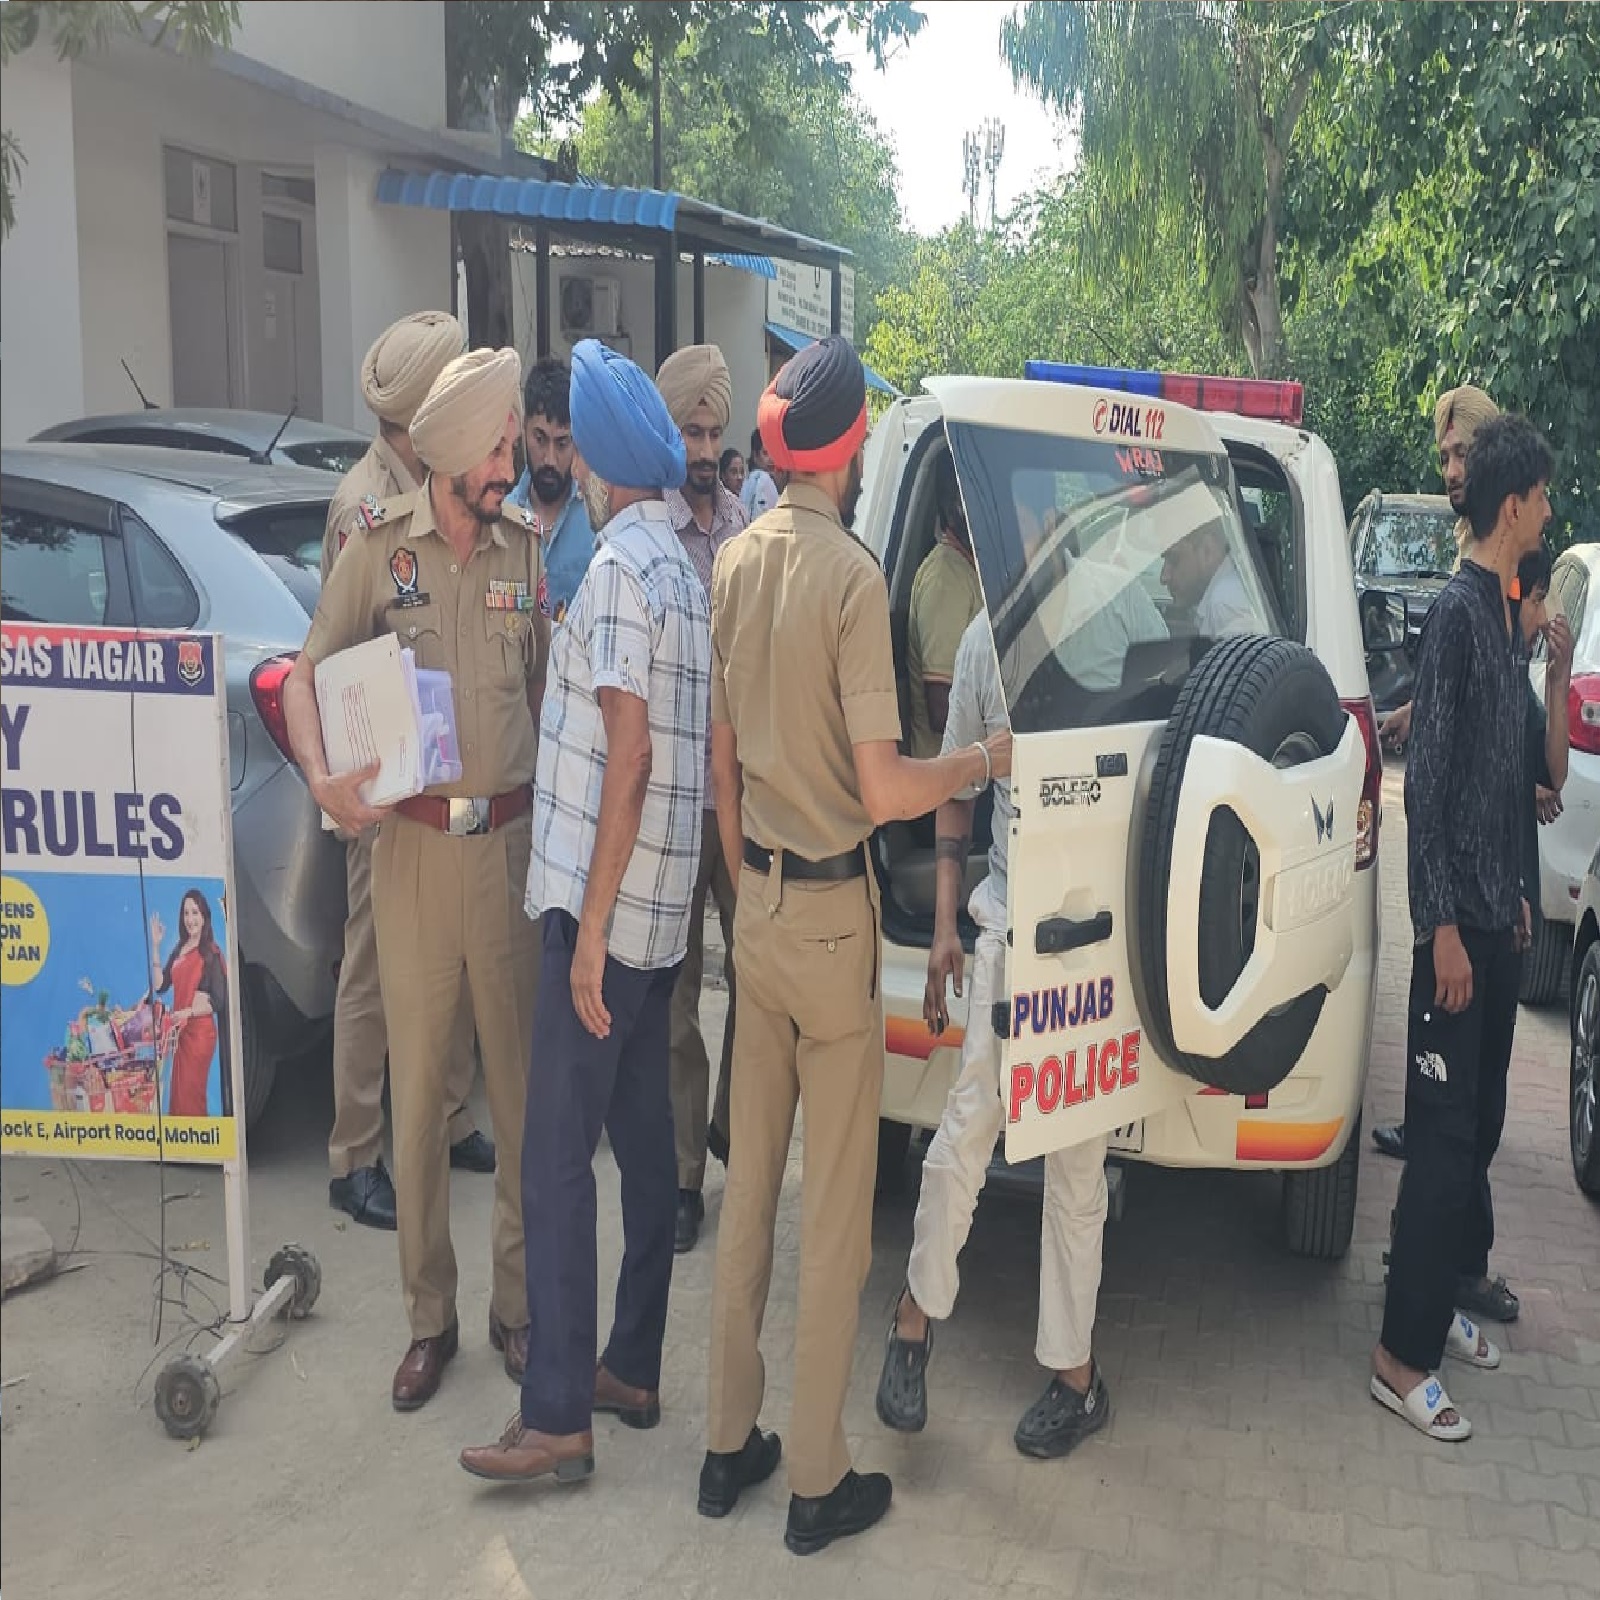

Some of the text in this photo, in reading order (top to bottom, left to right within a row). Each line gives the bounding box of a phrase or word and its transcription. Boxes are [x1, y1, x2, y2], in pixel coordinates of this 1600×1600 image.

[1109, 403, 1165, 440] DIAL 112
[1, 634, 166, 683] SAS NAGAR
[1, 704, 31, 770] Y
[1, 788, 185, 861] RULES
[7, 946, 40, 961] JAN
[1012, 976, 1114, 1040] PUNJAB
[1008, 1030, 1141, 1123] POLICE
[37, 1122, 49, 1141] E,
[54, 1121, 111, 1145] Airport
[115, 1124, 160, 1146] Road,
[165, 1127, 220, 1145] Mohali
